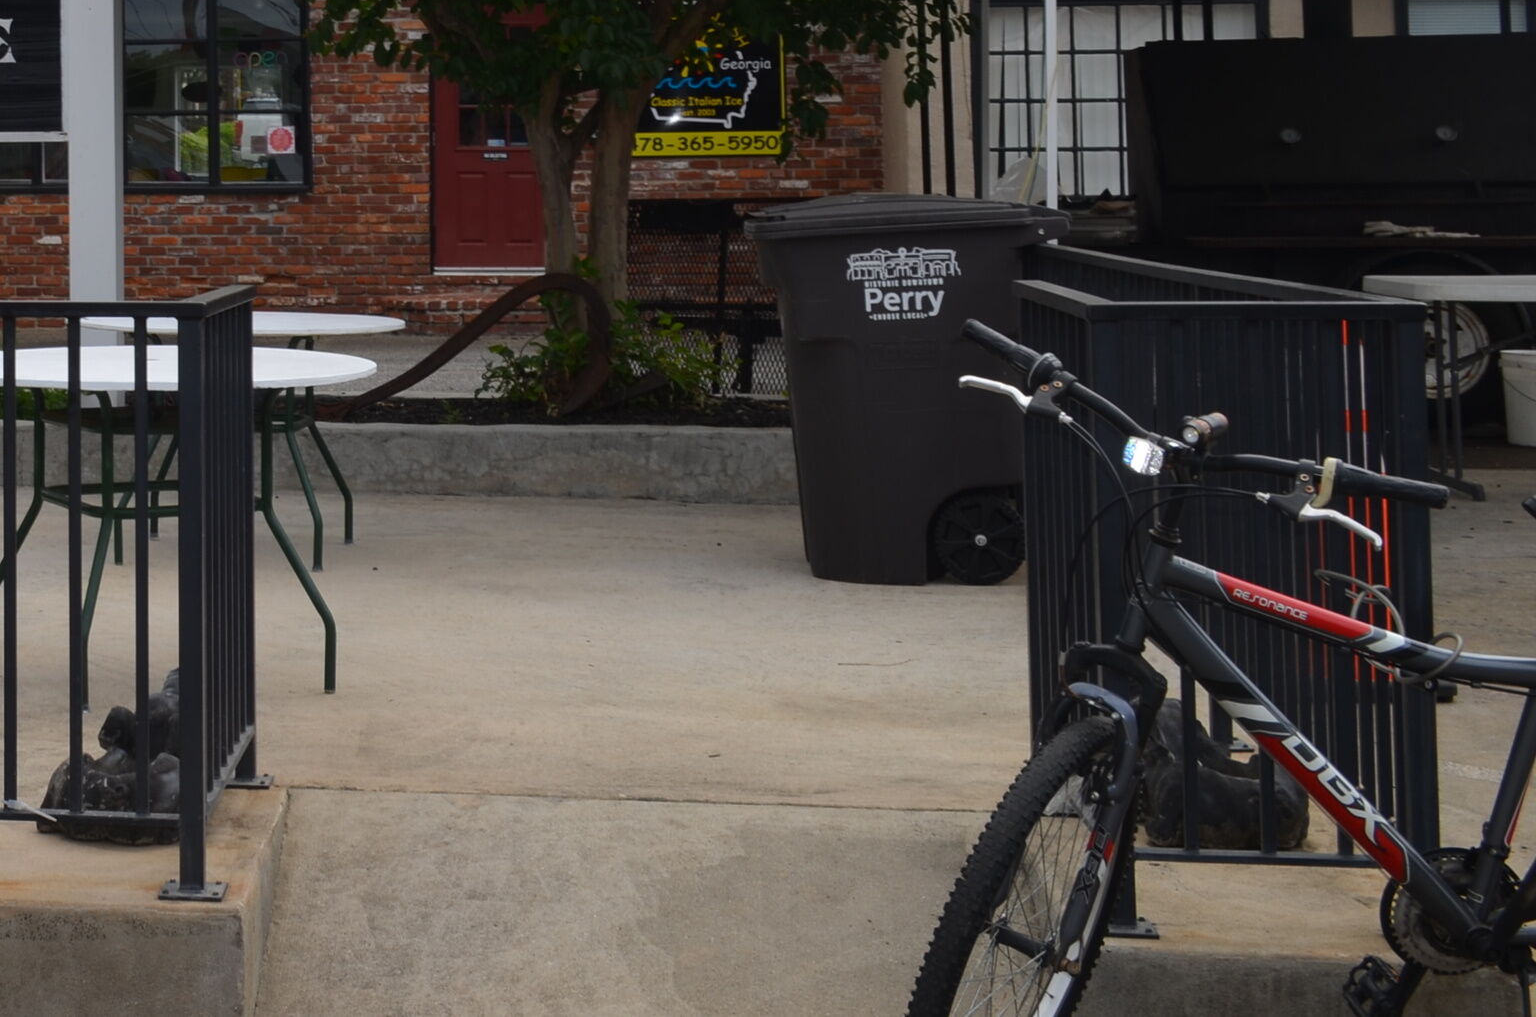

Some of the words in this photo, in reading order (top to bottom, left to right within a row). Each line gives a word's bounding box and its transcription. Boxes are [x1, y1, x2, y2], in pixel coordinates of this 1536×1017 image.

[234, 51, 288, 69] open
[720, 57, 771, 74] Georgia
[650, 95, 685, 107] Classic
[688, 95, 722, 106] Italian
[724, 95, 743, 106] Ice
[864, 280, 899, 288] HISTORIC
[902, 278, 944, 287] DOWNTOWN
[864, 288, 945, 317] Perry
[1281, 735, 1387, 846] DBX
